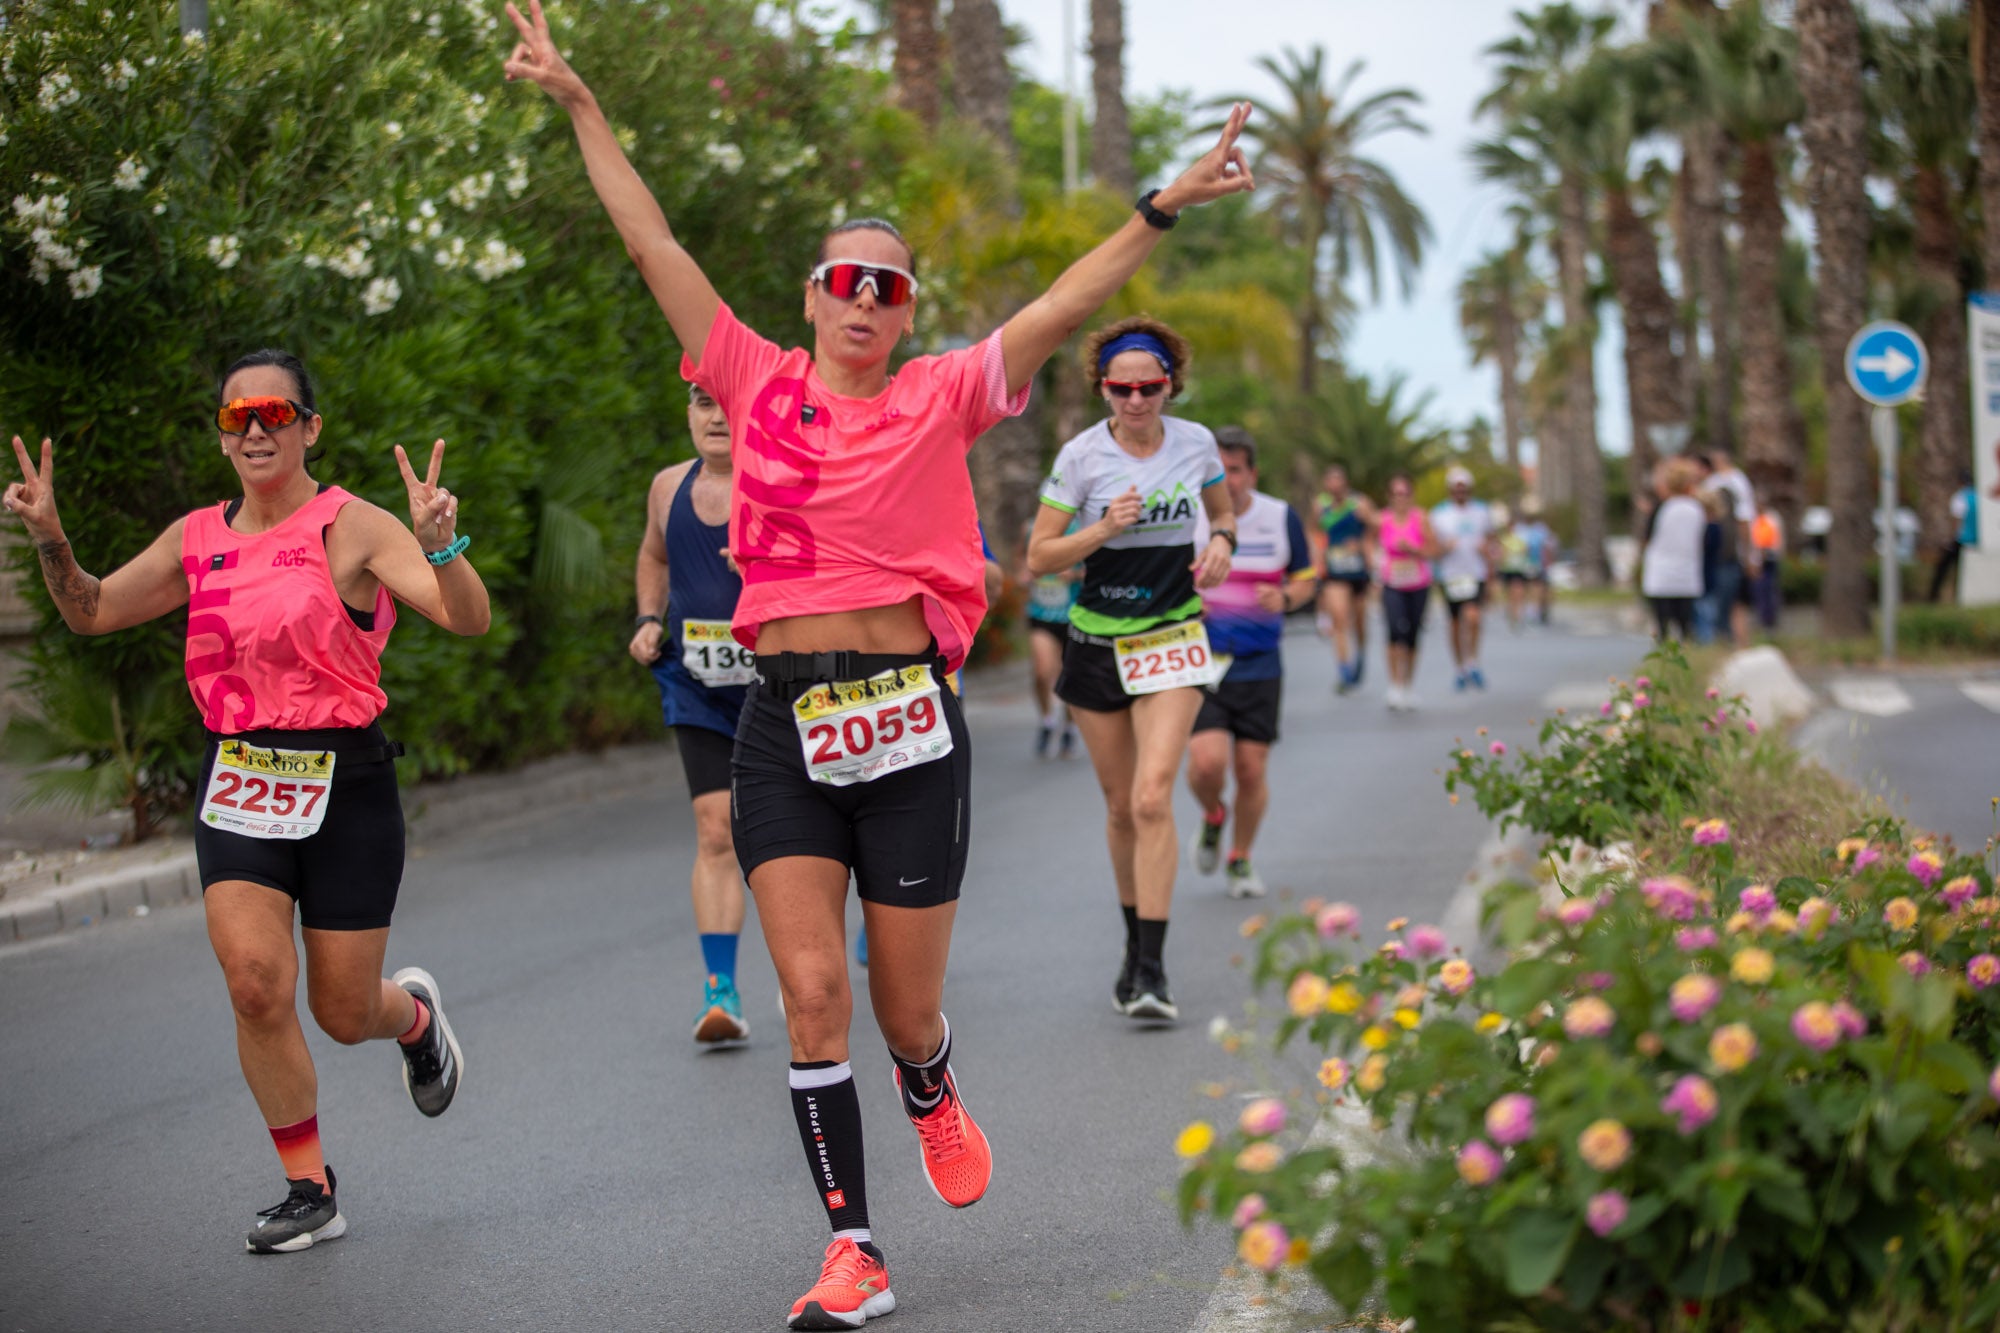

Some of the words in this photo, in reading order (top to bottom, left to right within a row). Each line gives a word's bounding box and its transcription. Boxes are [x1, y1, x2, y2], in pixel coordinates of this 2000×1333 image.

[698, 646, 755, 669] 136
[1123, 645, 1206, 682] 2250
[808, 696, 937, 765] 2059
[250, 750, 271, 759] GRAN
[210, 771, 326, 818] 2257
[807, 1096, 835, 1188] COMPRESSPORT
